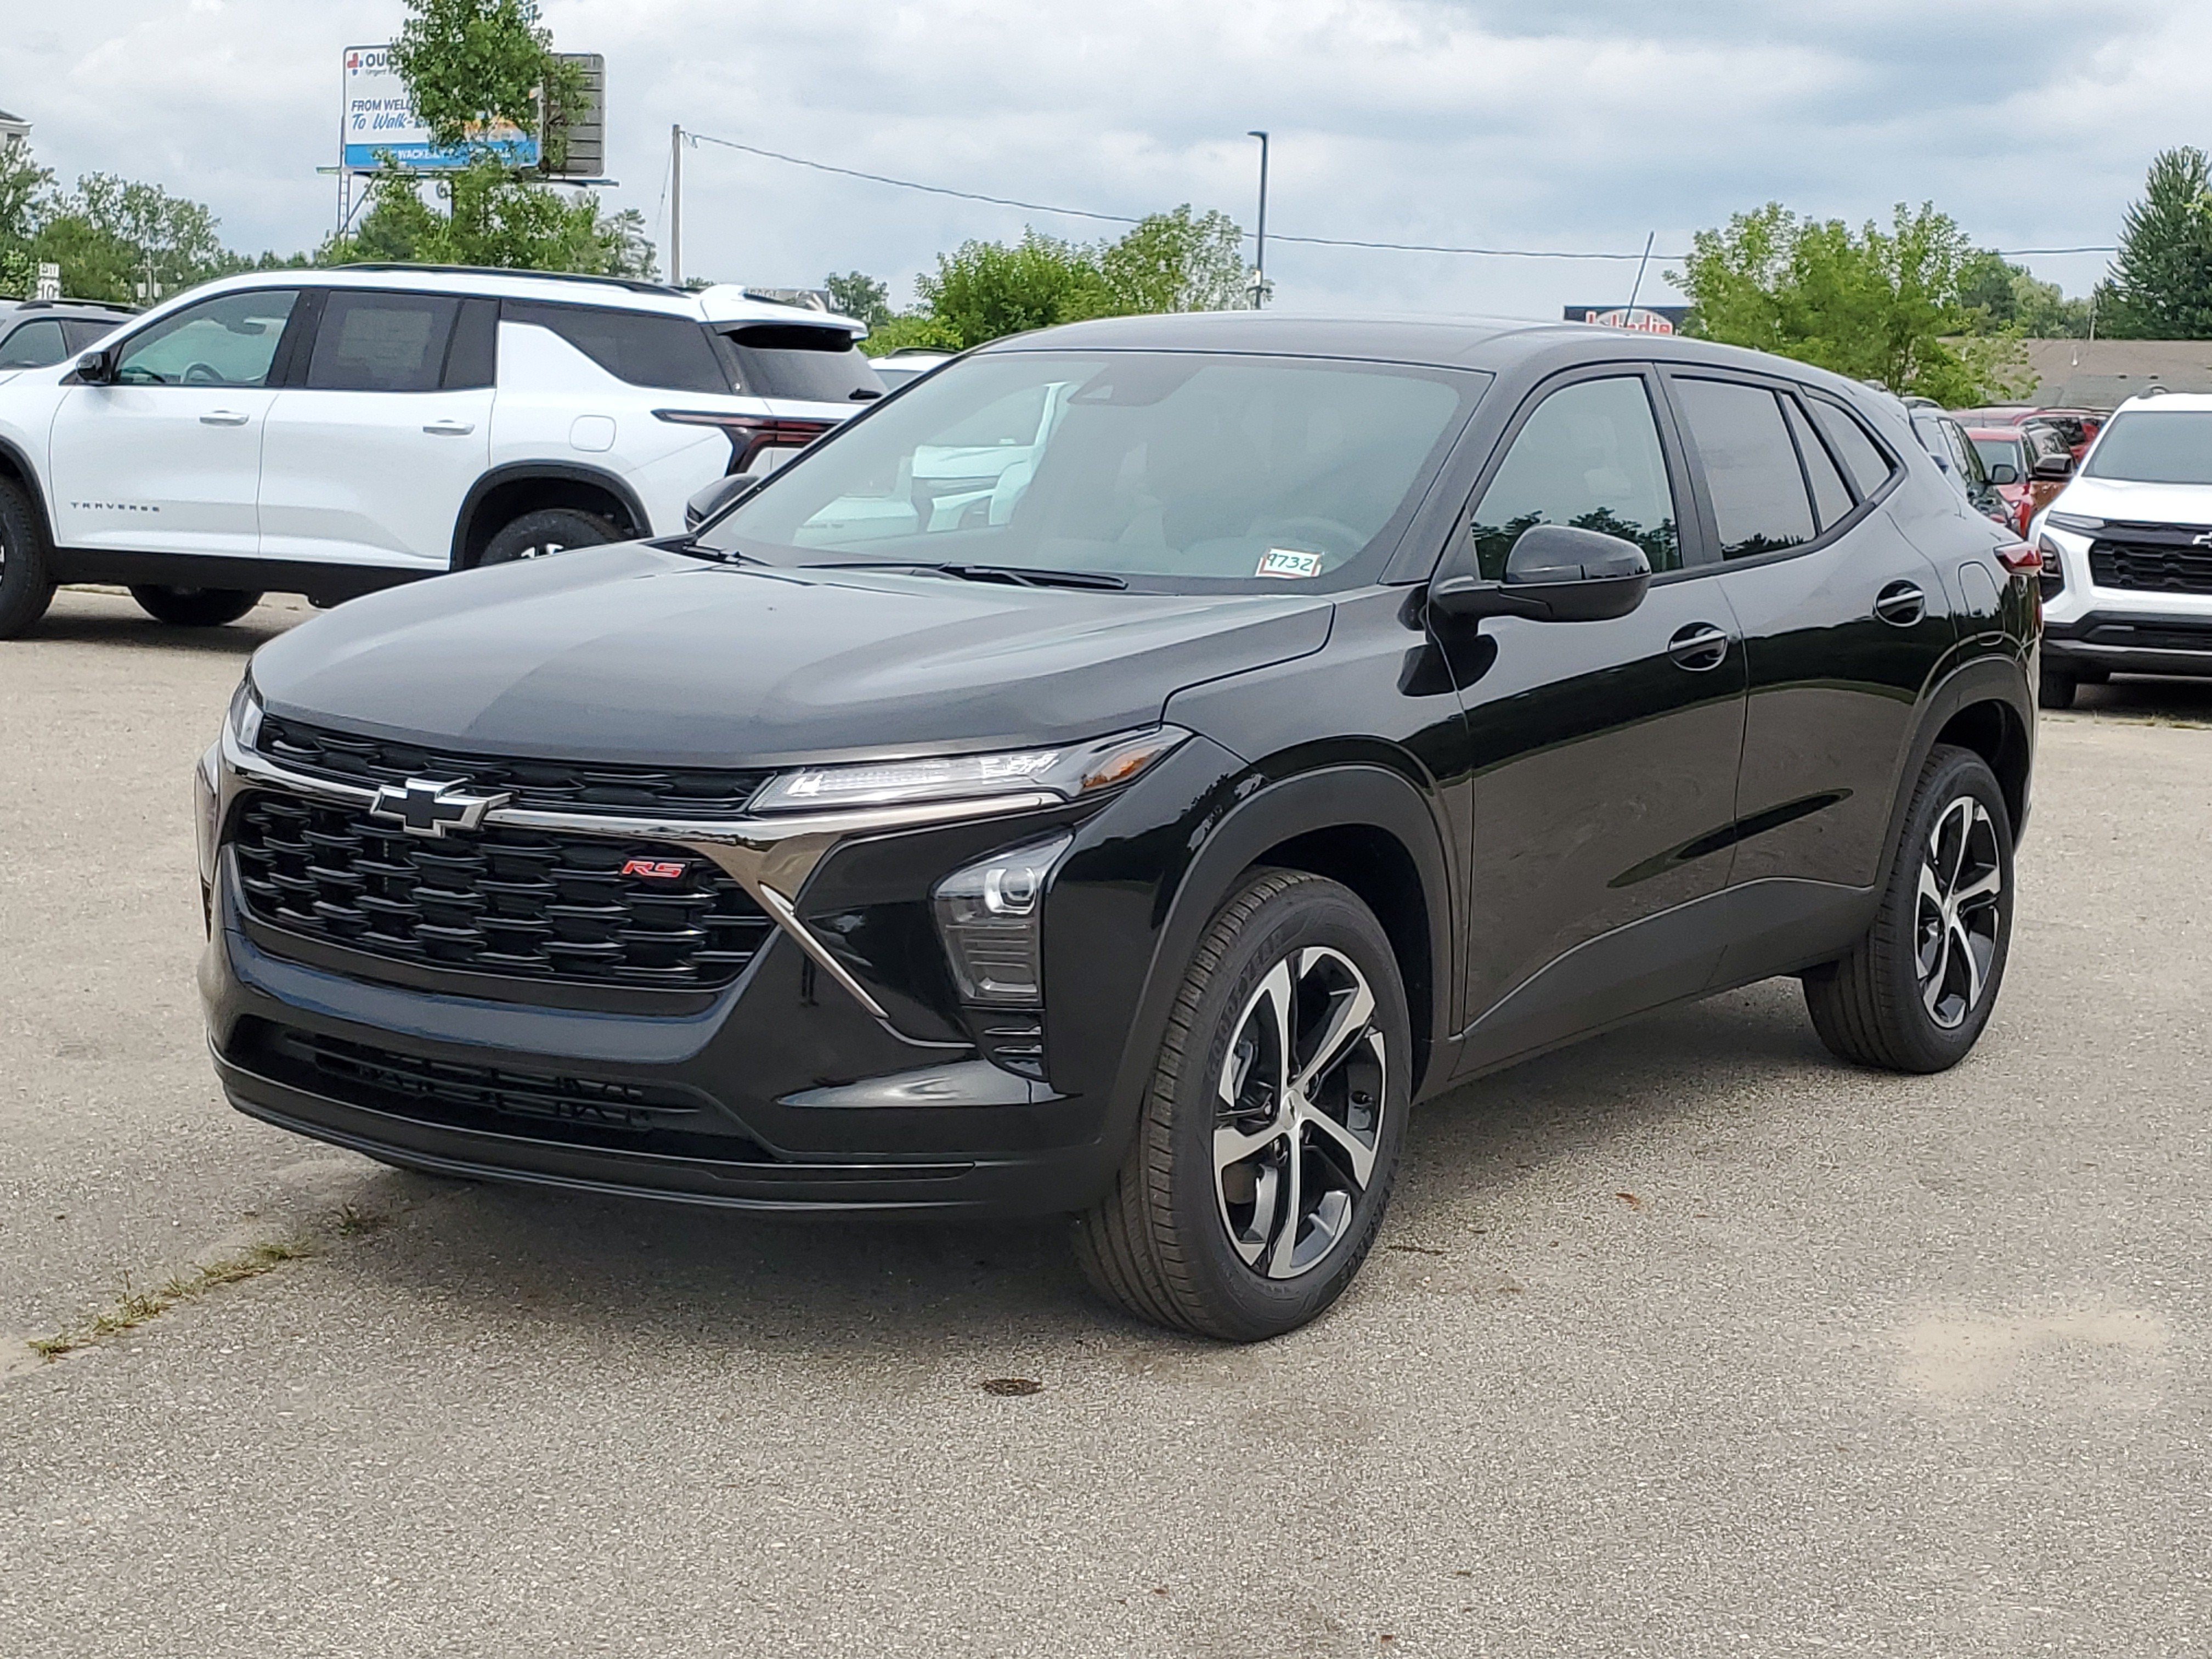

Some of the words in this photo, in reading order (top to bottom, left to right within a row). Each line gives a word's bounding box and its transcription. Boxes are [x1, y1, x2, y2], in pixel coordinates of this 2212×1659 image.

[351, 99, 382, 111] FROM
[384, 99, 413, 111] WELL
[352, 113, 366, 129] To
[70, 501, 160, 512] TRAVERSE
[1267, 553, 1313, 572] 9732
[622, 860, 686, 878] RS
